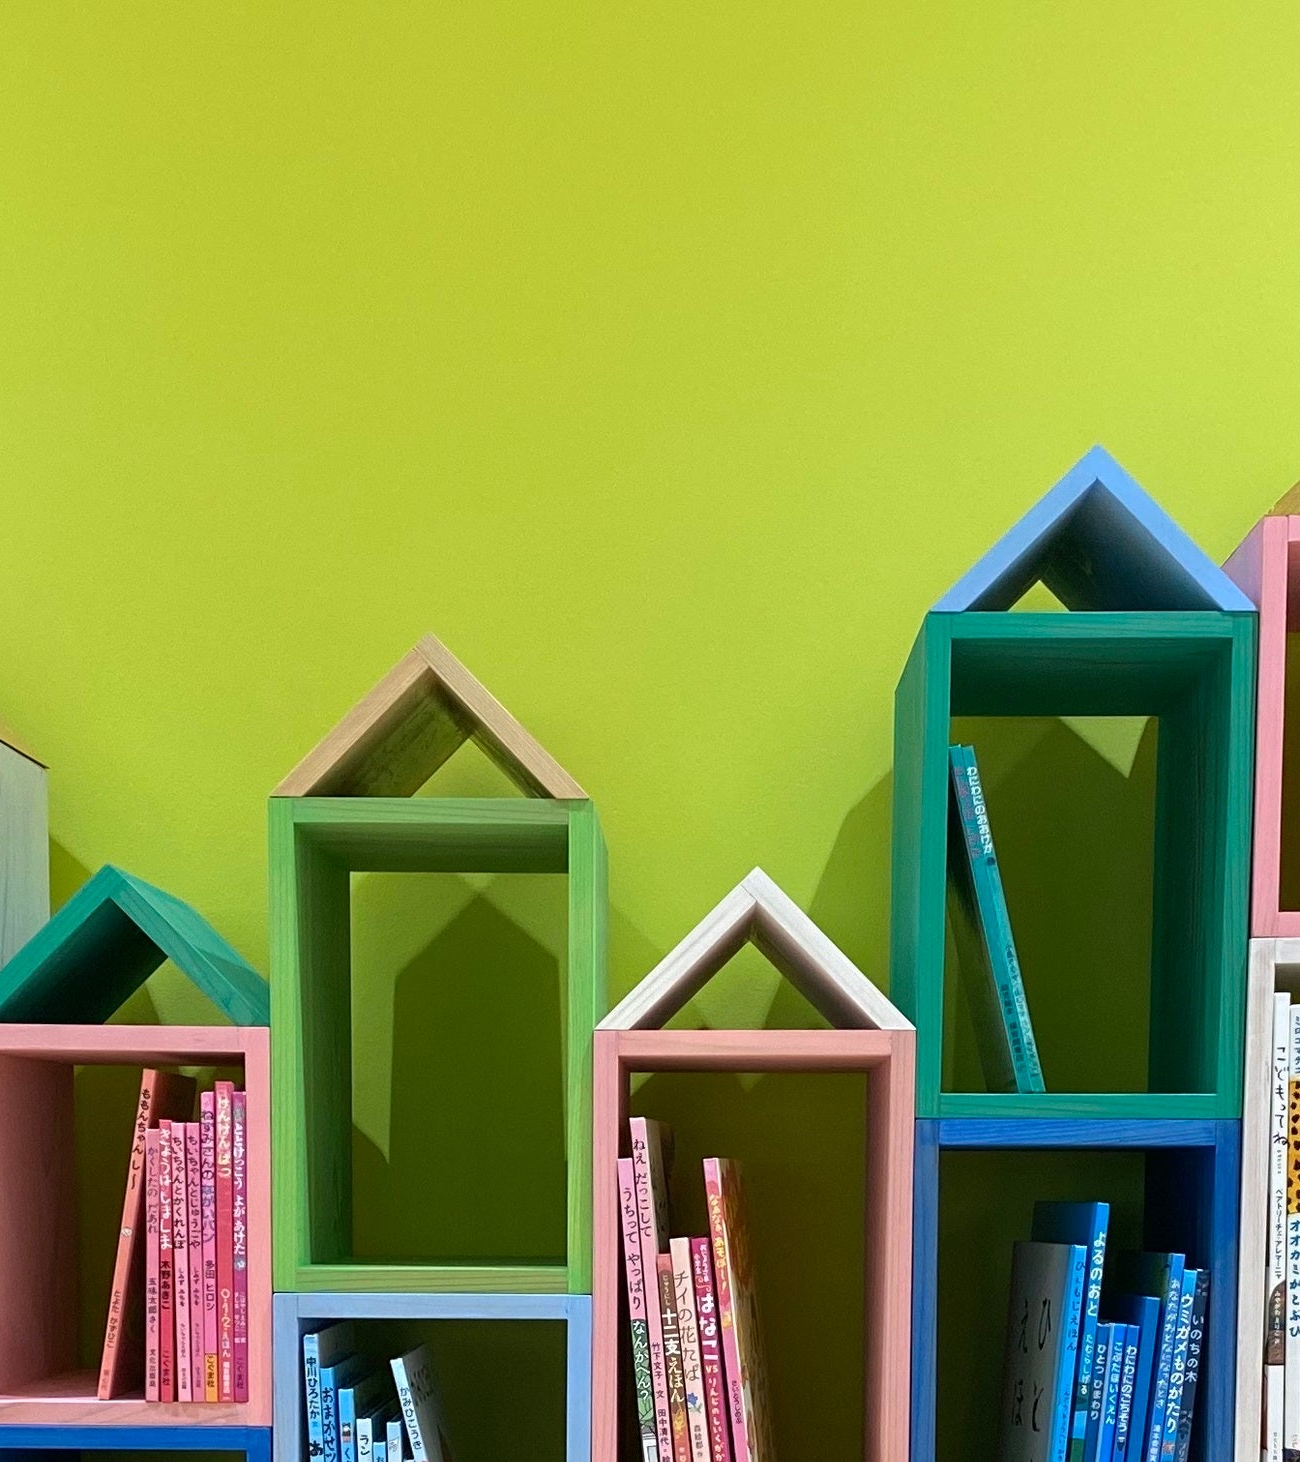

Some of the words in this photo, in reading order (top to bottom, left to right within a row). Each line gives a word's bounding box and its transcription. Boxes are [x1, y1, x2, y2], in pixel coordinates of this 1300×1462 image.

[632, 1138, 647, 1165] ねえ
[622, 1187, 639, 1244] うちって
[635, 1172, 652, 1238] だっこして
[627, 1252, 644, 1310] やっぱり
[1086, 1231, 1107, 1317] よるのおと
[661, 1308, 681, 1356] 十二支
[673, 1270, 701, 1382] チイの花たば
[1184, 1315, 1206, 1383] いのちの木
[305, 1356, 320, 1419] 中川ひろたか
[667, 1356, 685, 1403] えほん
[1104, 1341, 1124, 1425] こぶたほいくえん
[1165, 1293, 1195, 1434] ウミガメものがたり
[400, 1387, 423, 1451] かみひこうき
